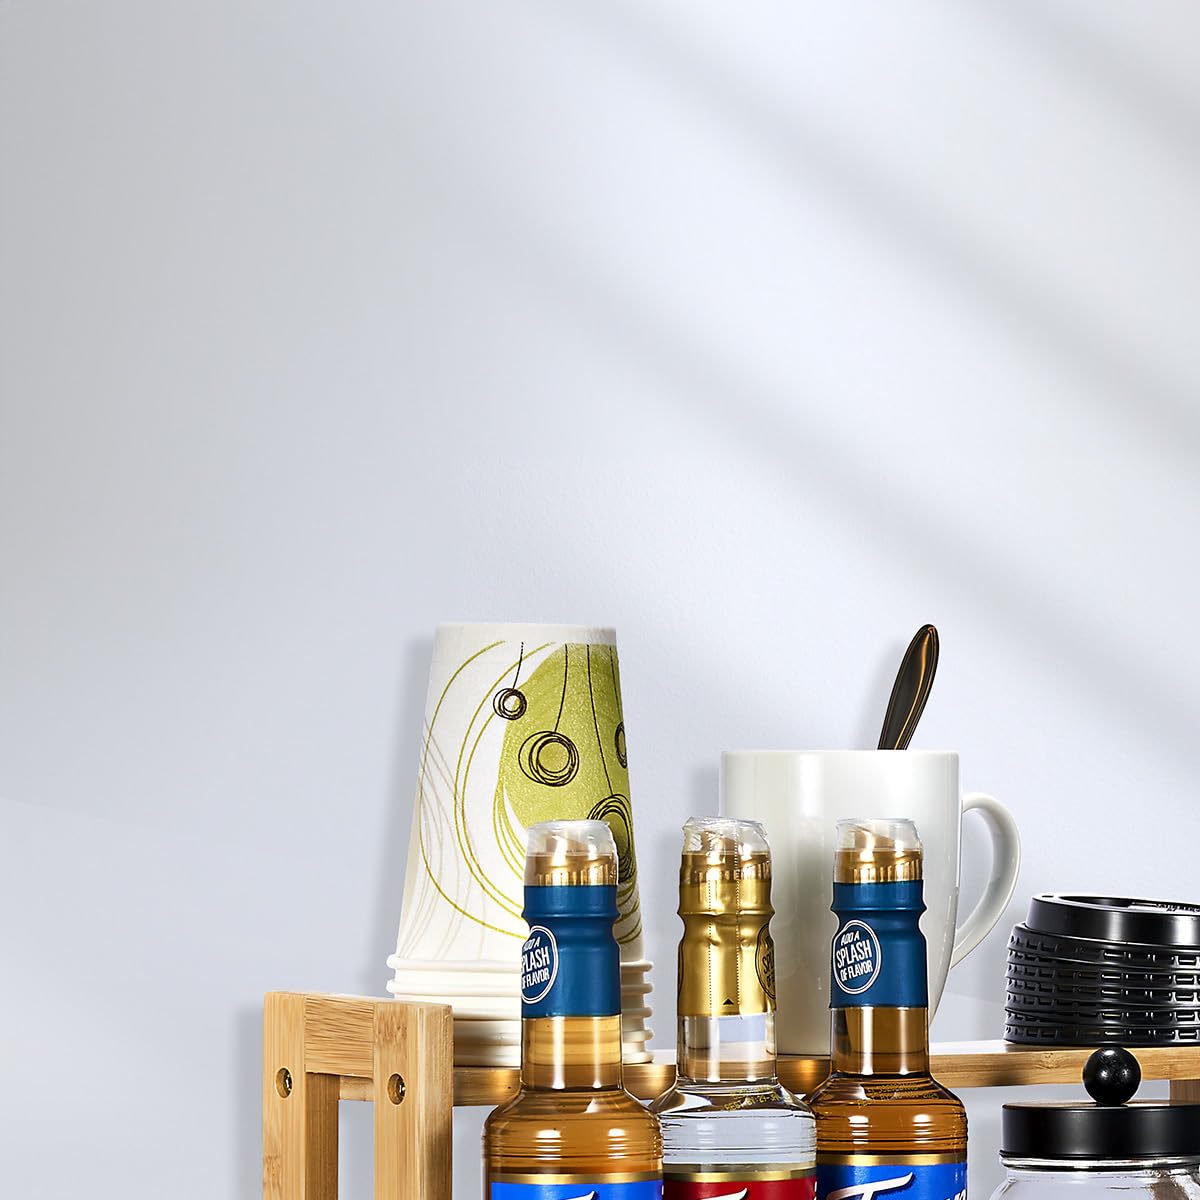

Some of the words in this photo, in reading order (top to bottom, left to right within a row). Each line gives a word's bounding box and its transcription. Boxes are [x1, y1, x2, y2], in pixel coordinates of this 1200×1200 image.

[836, 939, 872, 968] SPLASH
[841, 968, 848, 982] OF
[848, 960, 873, 979] FLAVOR
